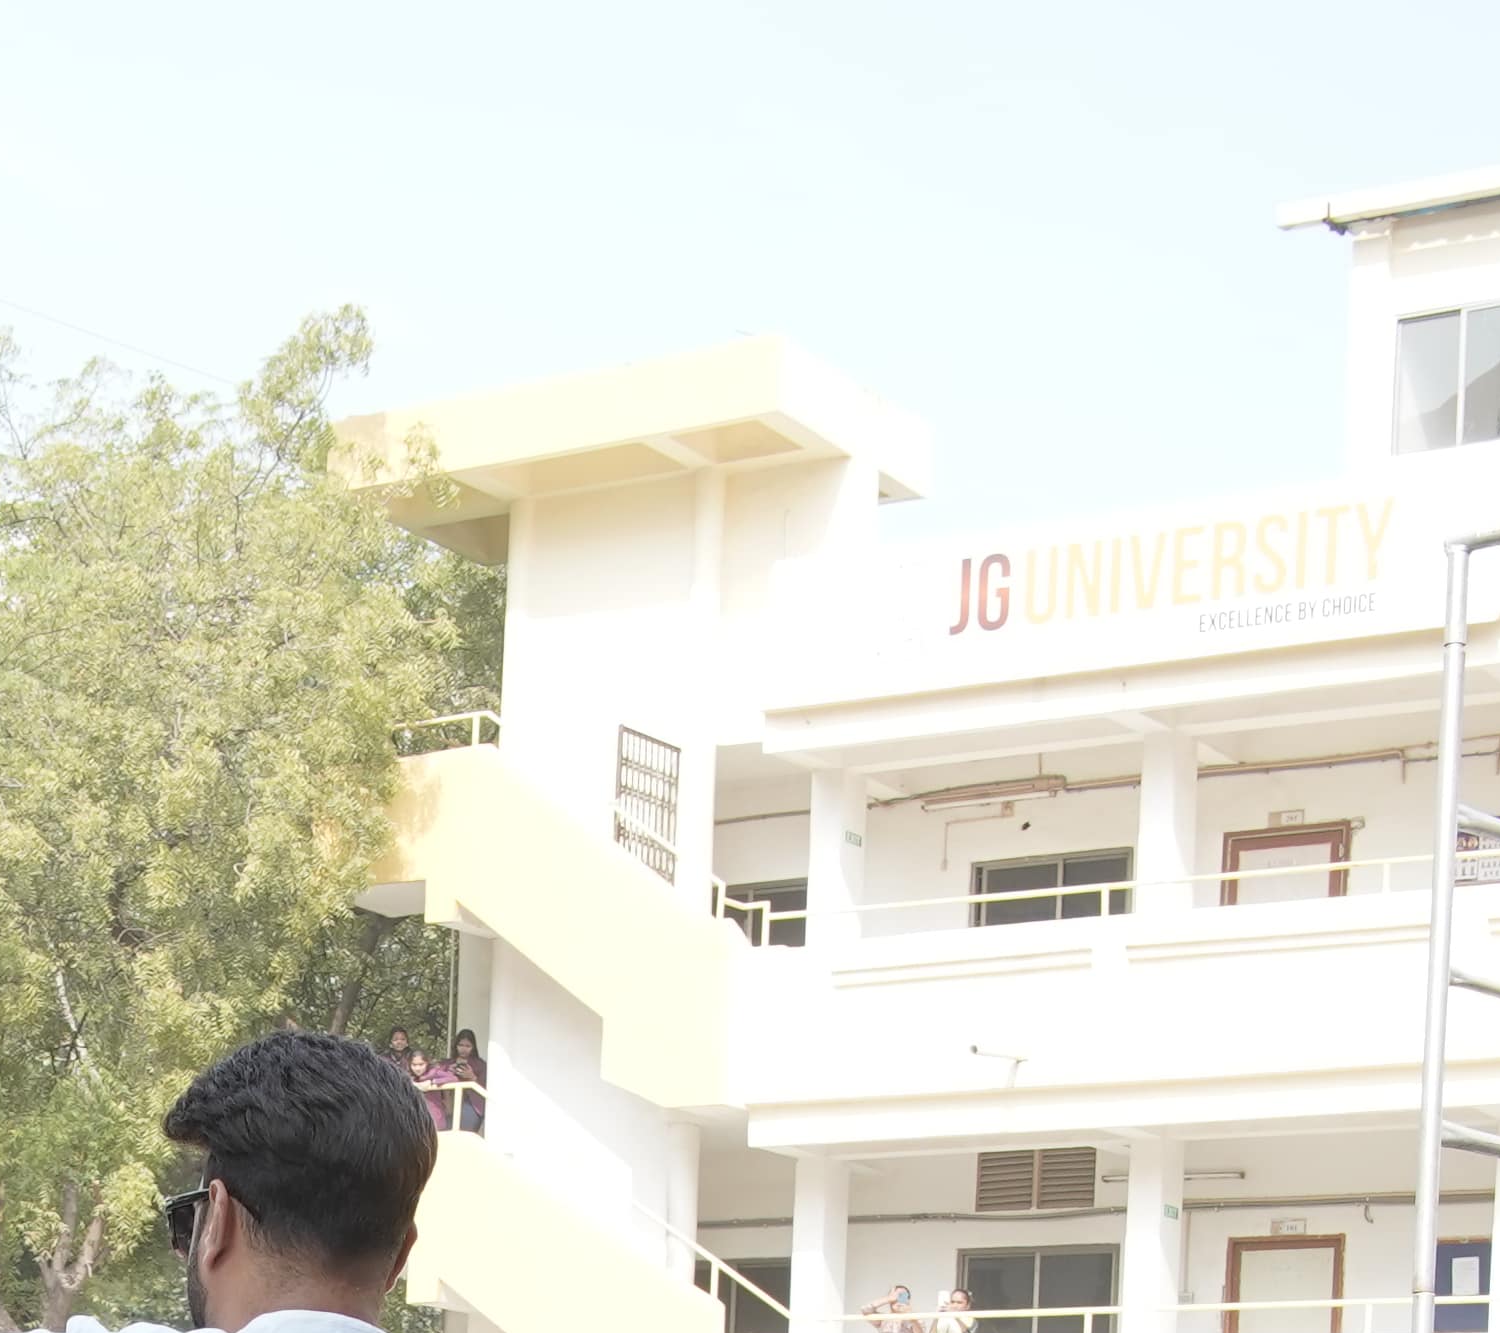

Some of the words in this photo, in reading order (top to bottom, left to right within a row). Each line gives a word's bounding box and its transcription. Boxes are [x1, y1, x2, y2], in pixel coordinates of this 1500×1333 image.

[949, 553, 1012, 636] JG
[1024, 497, 1397, 625] UNIVERSITY
[1199, 606, 1293, 633] EXCELLENCE
[1298, 602, 1317, 621] BY
[1322, 592, 1377, 618] CHOICE
